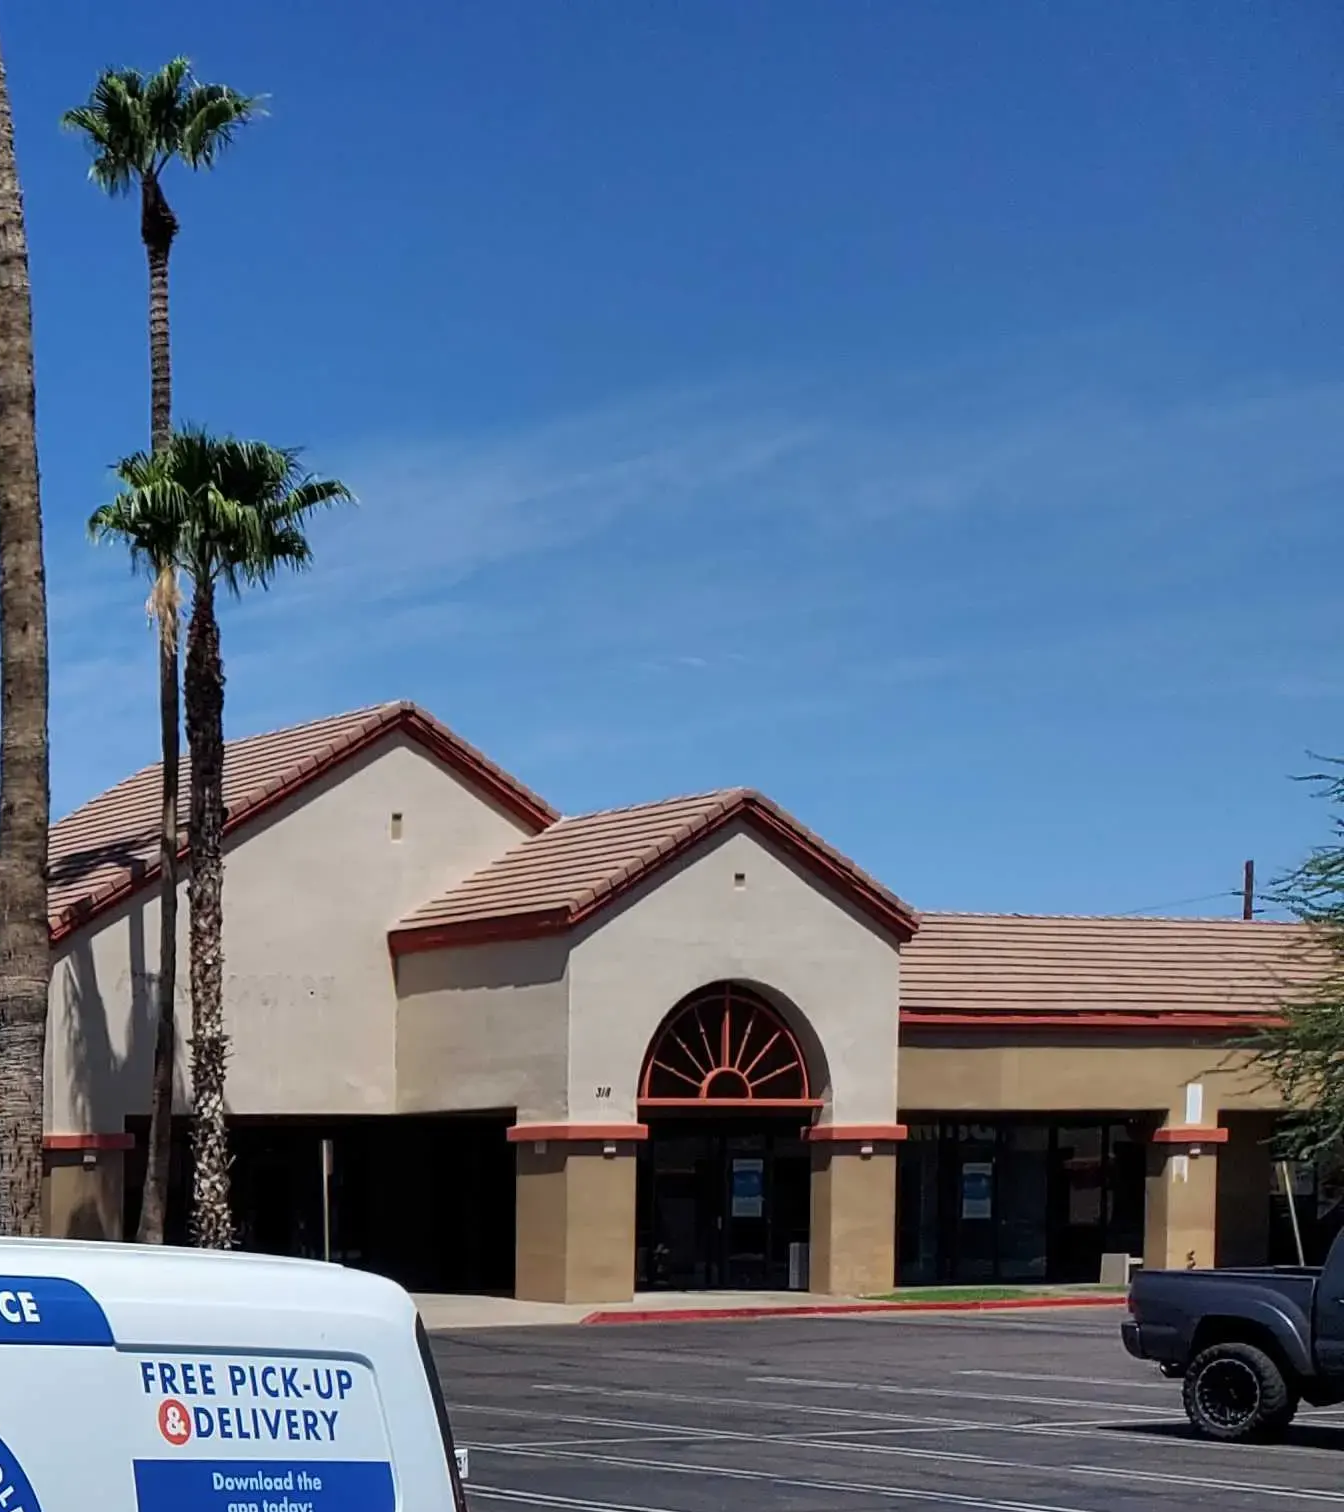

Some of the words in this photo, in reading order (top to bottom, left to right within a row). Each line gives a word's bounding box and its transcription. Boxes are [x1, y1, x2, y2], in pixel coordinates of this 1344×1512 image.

[140, 1362, 216, 1395] FREE
[228, 1365, 353, 1400] PICK-UP
[165, 1407, 187, 1436] &
[193, 1406, 338, 1441] DELIVERY
[212, 1470, 294, 1491] Download
[297, 1471, 322, 1491] the
